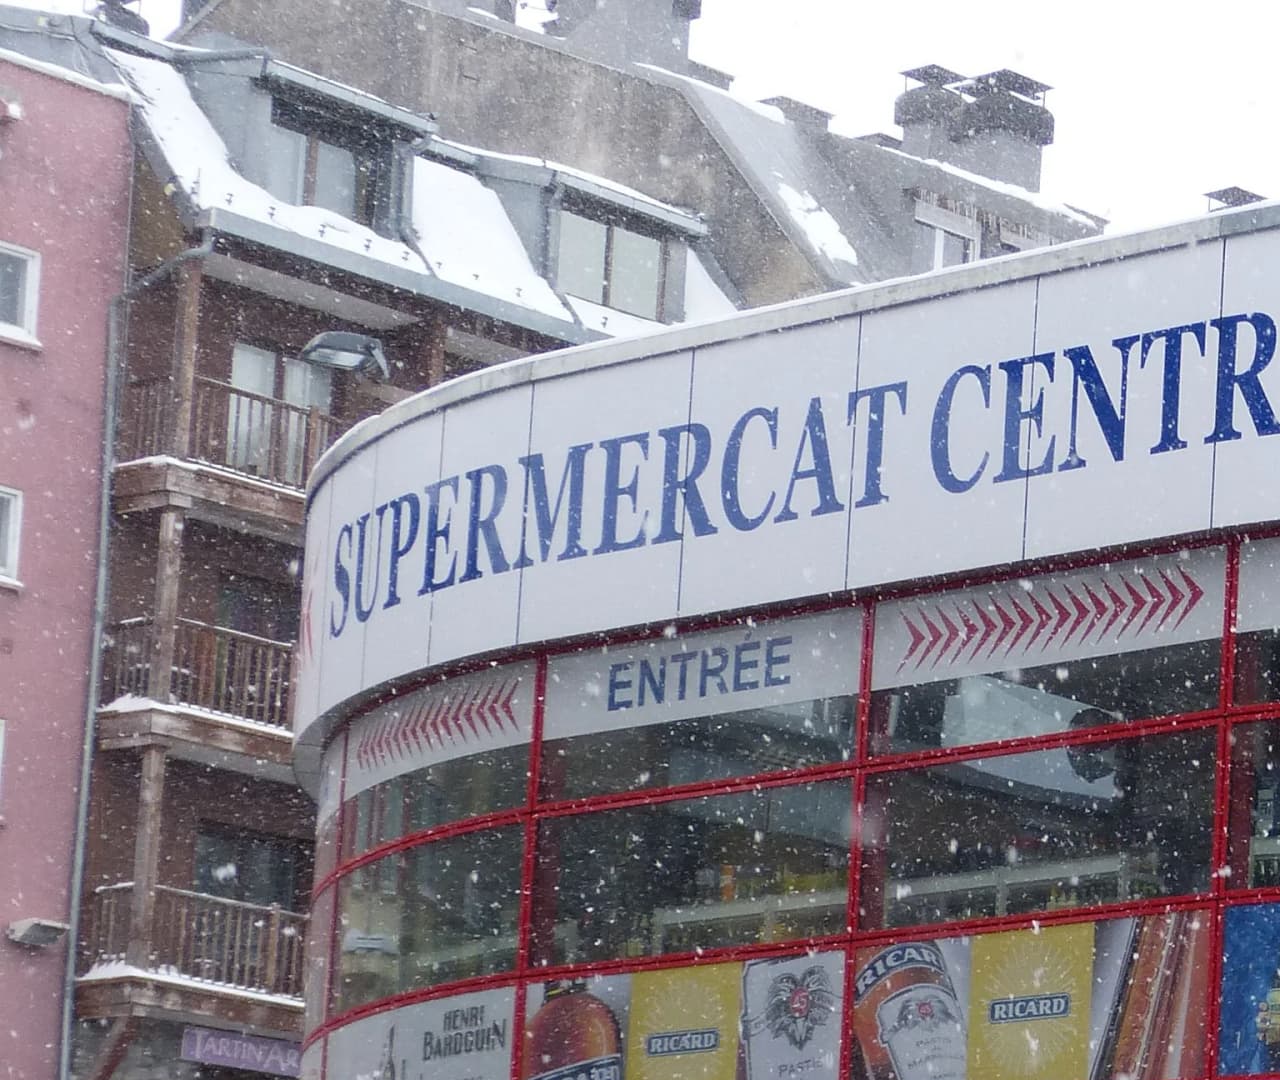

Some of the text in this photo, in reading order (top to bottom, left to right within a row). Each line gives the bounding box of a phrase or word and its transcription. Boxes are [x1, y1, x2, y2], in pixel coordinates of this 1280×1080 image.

[329, 381, 908, 639] SUPERMERCAT
[607, 631, 794, 713] ENTRÉE
[856, 946, 944, 998] RICAR
[443, 1005, 485, 1032] HENRI
[993, 996, 1067, 1021] RICARD
[650, 1033, 717, 1053] RICARD
